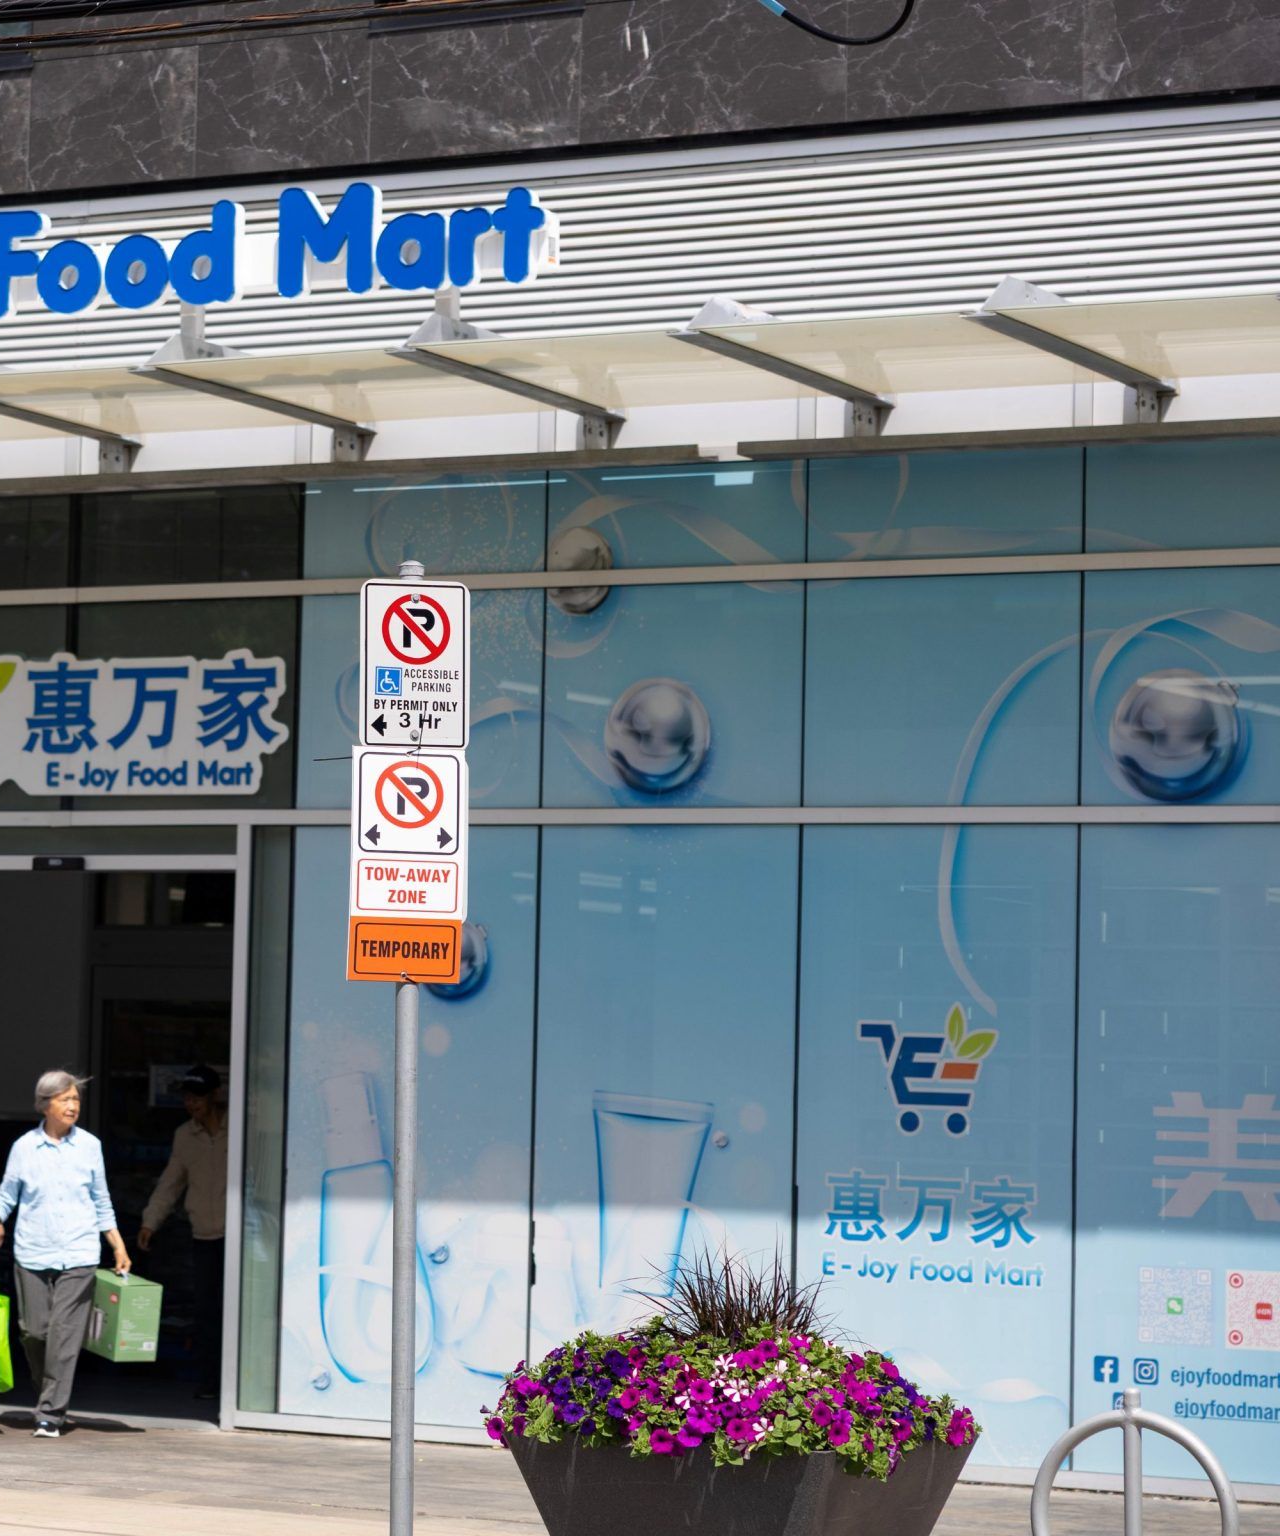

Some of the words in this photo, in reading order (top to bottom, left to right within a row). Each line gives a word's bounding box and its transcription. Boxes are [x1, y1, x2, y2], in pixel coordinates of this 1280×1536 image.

[277, 182, 545, 298] Mart
[404, 669, 460, 680] ACCESSIBLE
[411, 682, 452, 693] PARKING
[22, 658, 280, 755] 惠万家
[373, 699, 387, 710] BY
[390, 700, 429, 711] PERMIT
[432, 701, 458, 712] ONLY
[398, 712, 411, 728] 3
[418, 713, 442, 729] Hr
[127, 760, 189, 787] Food
[197, 760, 254, 787] Mart
[364, 866, 451, 883] TOW-AWAY
[387, 889, 427, 904] ZONE
[360, 939, 450, 960] TEMPORARY
[1151, 1091, 1280, 1221] 美
[825, 1170, 1037, 1248] 惠万家
[909, 1257, 973, 1283] Food
[984, 1260, 1044, 1287] Mart
